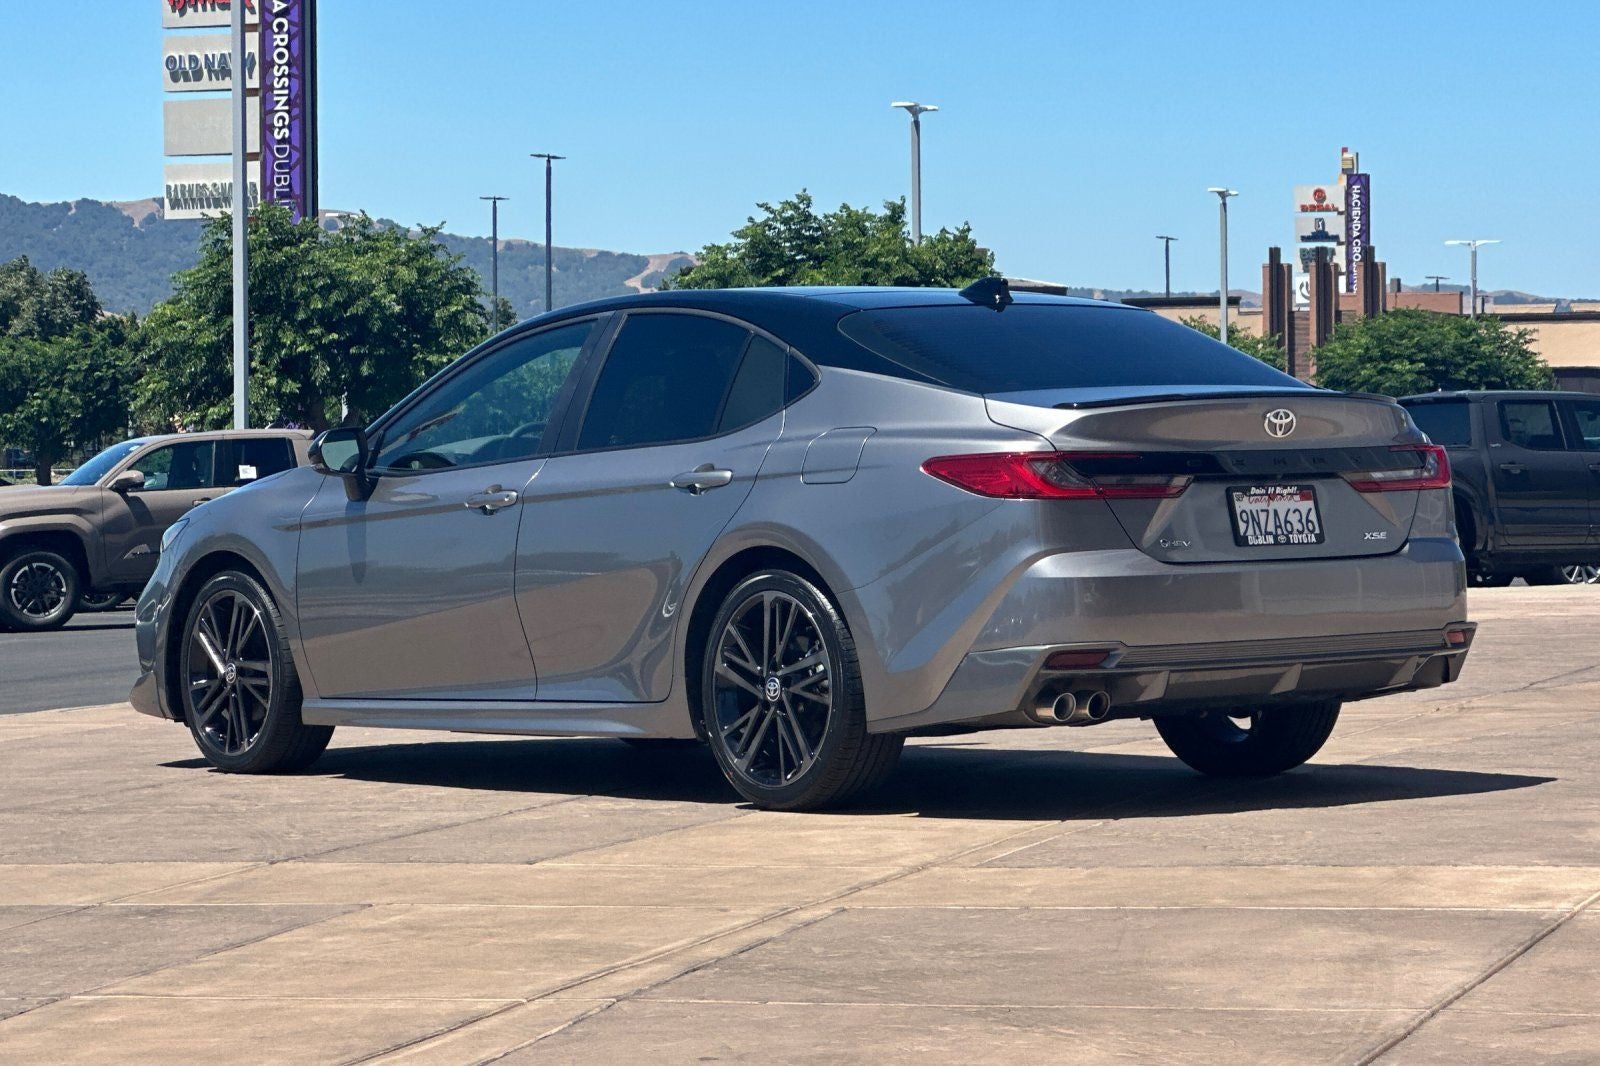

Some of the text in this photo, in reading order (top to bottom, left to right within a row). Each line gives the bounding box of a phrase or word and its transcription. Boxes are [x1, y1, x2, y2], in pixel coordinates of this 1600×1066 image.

[165, 52, 257, 71] OLD NAY
[273, 17, 290, 140] CROSSINGS
[273, 144, 290, 208] DUBLI
[165, 184, 208, 199] BARNES
[1352, 185, 1361, 238] HACIENDA
[1239, 507, 1316, 535] 9NZA636
[1247, 533, 1317, 545] DUBLIN TOYOTA
[1364, 531, 1387, 540] XSE
